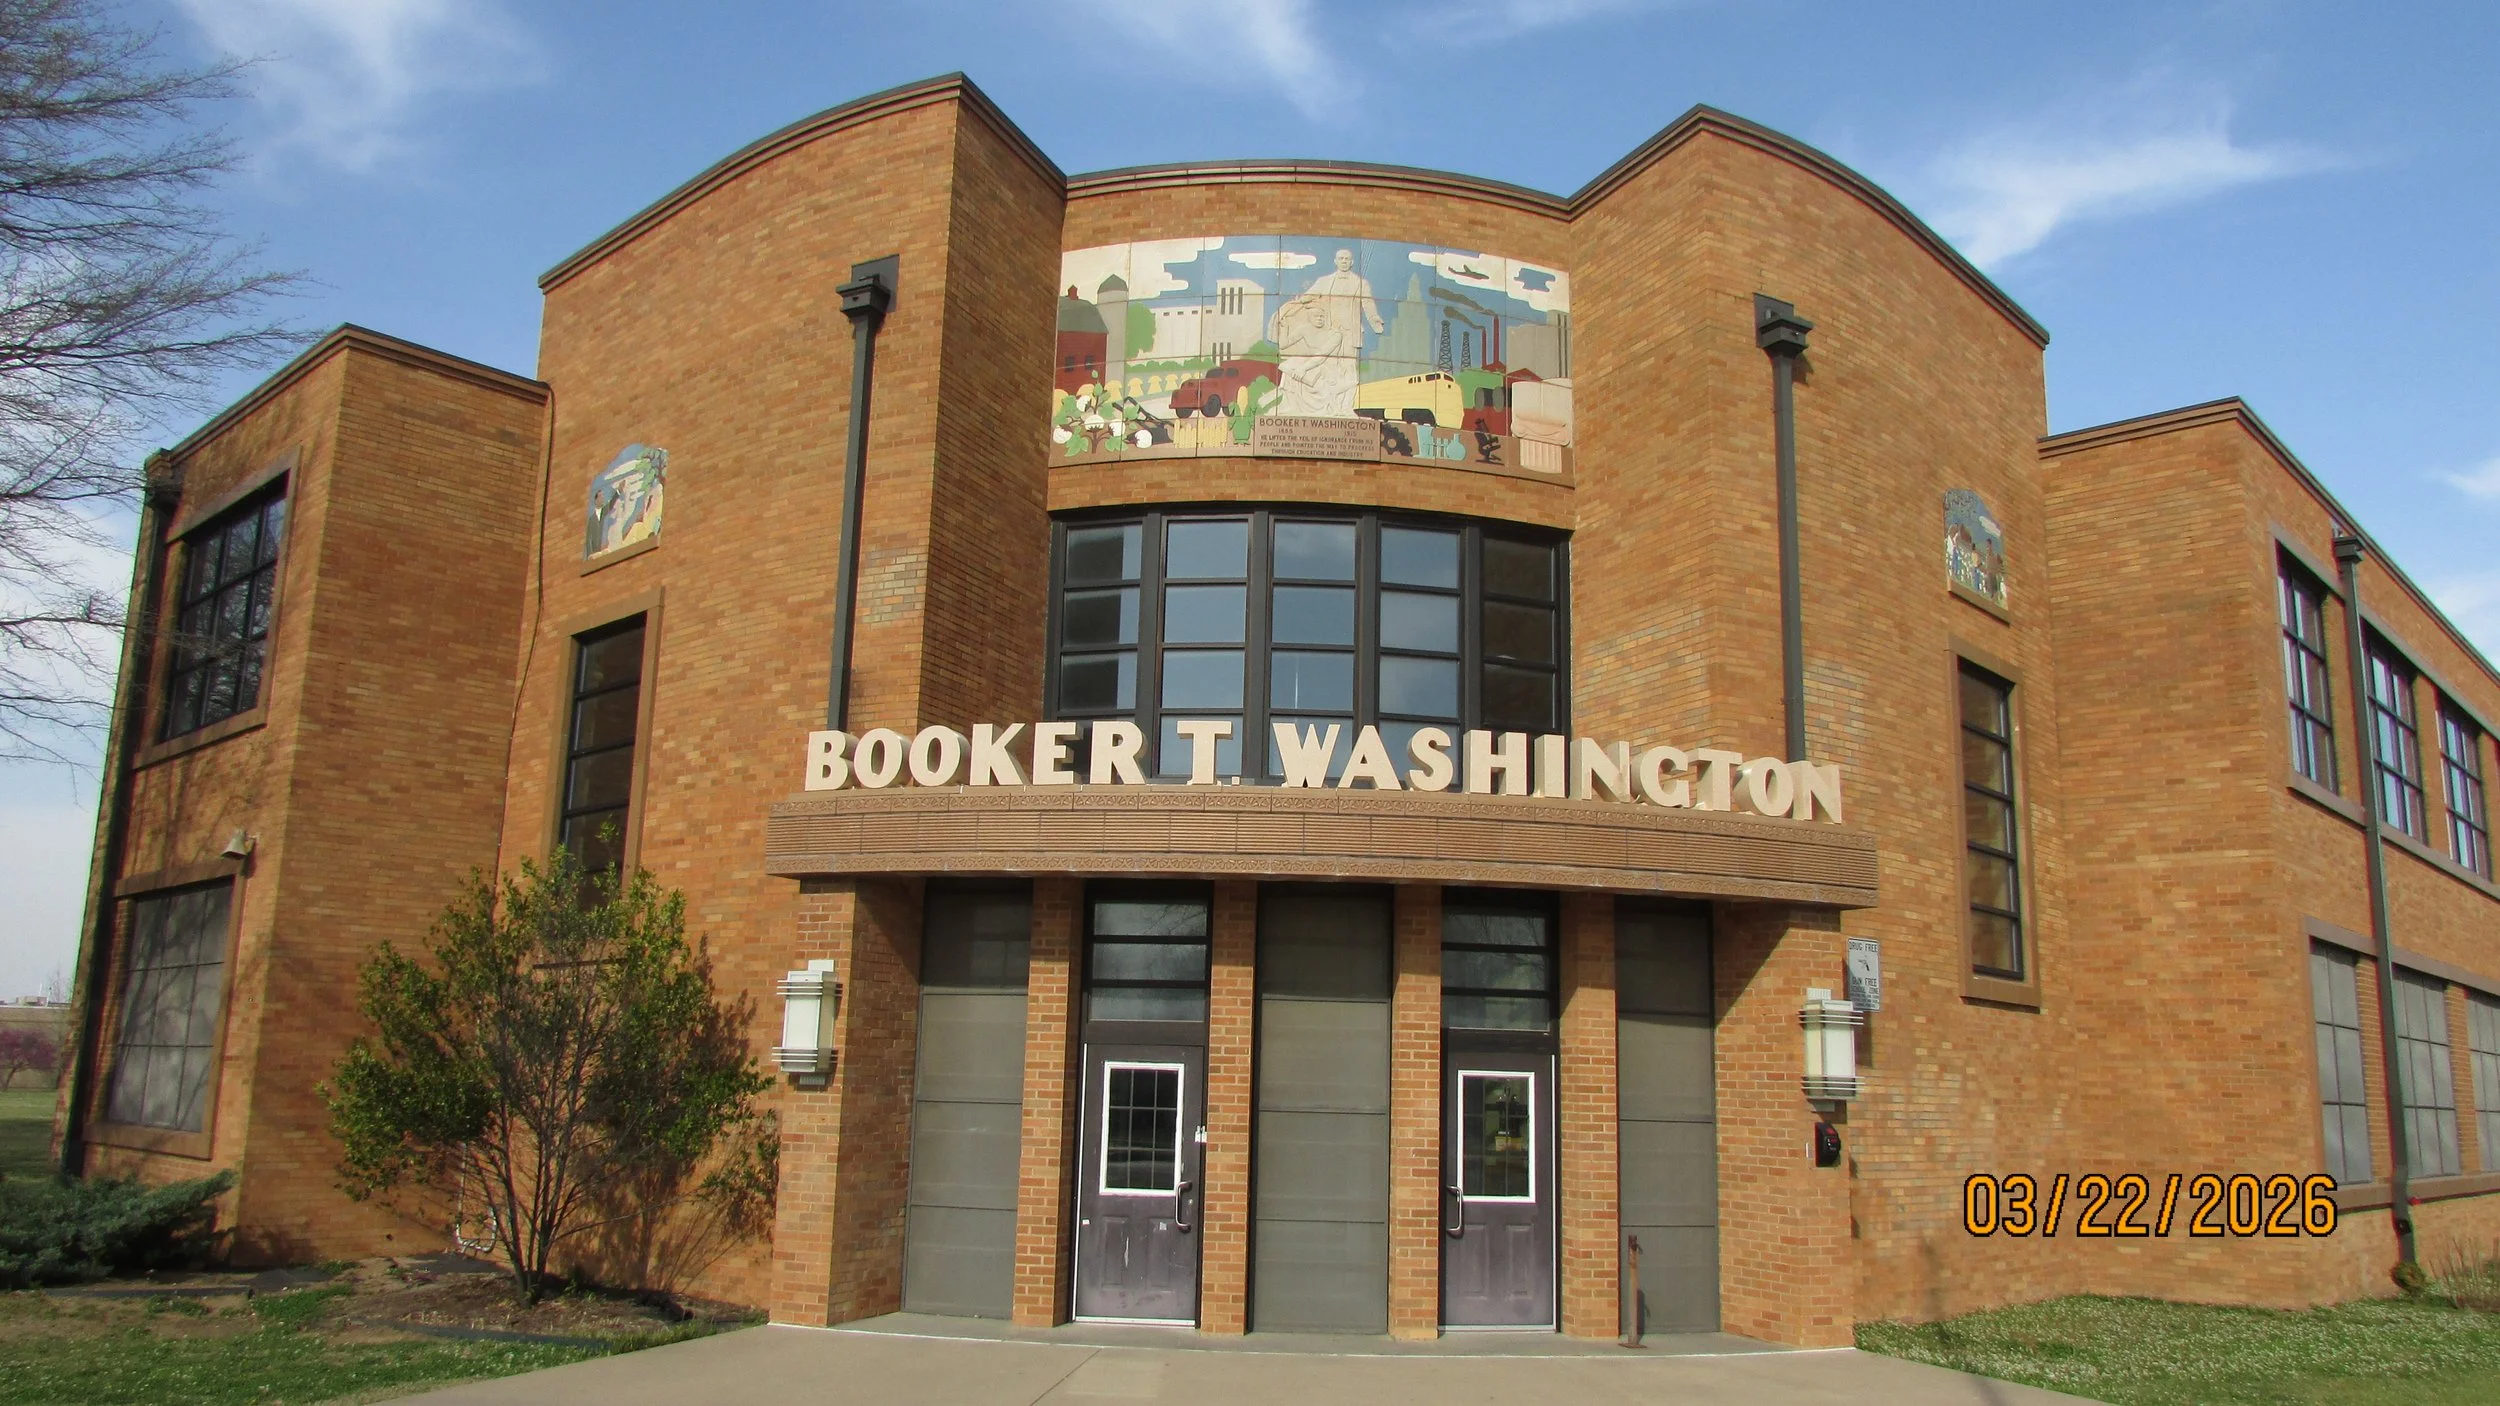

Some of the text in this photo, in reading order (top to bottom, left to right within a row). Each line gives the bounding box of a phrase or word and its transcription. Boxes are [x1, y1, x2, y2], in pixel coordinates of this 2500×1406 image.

[1259, 418, 1299, 427] BOOKER
[1310, 419, 1376, 431] WASHINGTON
[804, 720, 1147, 792] BOOKER
[1270, 721, 1844, 824] WASHINGTON
[1849, 941, 1878, 953] DRUG FREE
[1865, 977, 1878, 987] FREE
